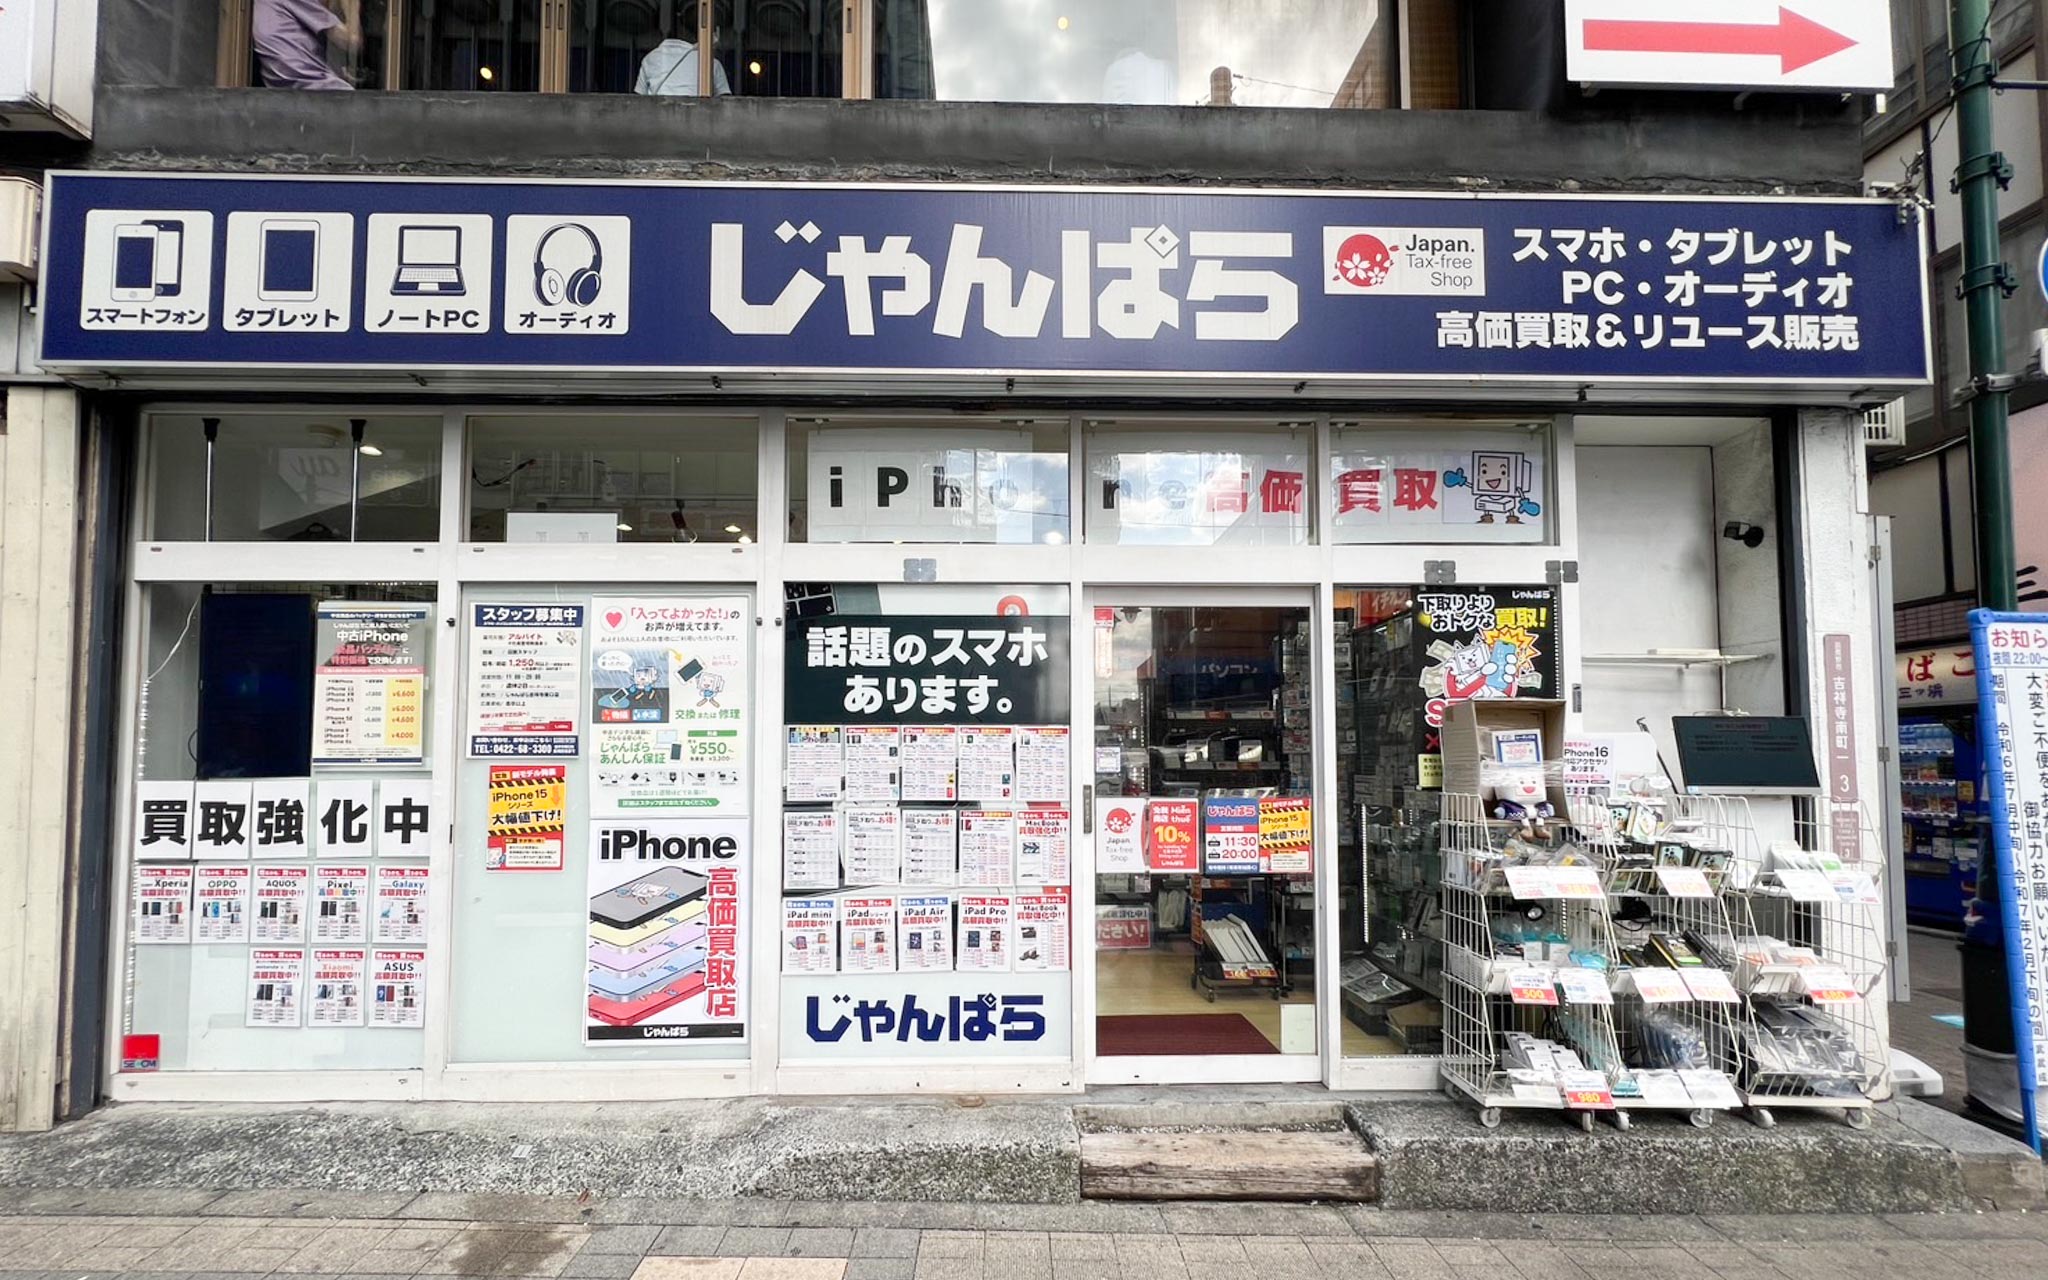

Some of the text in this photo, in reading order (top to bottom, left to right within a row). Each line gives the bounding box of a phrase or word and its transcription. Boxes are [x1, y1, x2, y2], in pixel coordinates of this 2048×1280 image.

[1405, 235, 1475, 254] Japan.
[1512, 227, 1853, 267] スマホ・タブレット
[1406, 254, 1473, 270] Tax-free
[710, 220, 1299, 340] じゃんぱら
[1431, 272, 1473, 290] Shop
[1563, 271, 1854, 308] PC・オーディオ
[86, 308, 205, 326] スマートフォン
[235, 309, 340, 328] タブレット
[376, 309, 479, 329] ノートPC
[518, 311, 617, 329] オーディオ
[1511, 590, 1551, 600] じゃんぱら
[1418, 594, 1495, 613] 下取りより
[482, 607, 578, 622] スタッフ募集中
[1431, 607, 1547, 632] おトクな 買取!
[336, 630, 409, 642] 中古iPhone
[806, 626, 1049, 667] 話題のスマホ
[843, 674, 1013, 715] あります。
[674, 709, 696, 720] 交換
[719, 708, 741, 720] 修理
[600, 753, 666, 765] あんしん保証
[1564, 746, 1609, 758] Phone16
[1840, 774, 1850, 793] 3
[492, 789, 548, 803] iPhone 15
[508, 801, 534, 810] シリーズ
[1208, 805, 1256, 817] じゃんぱら
[140, 797, 429, 846] 買取強化中
[492, 809, 562, 826] 大幅値下げ!
[1154, 825, 1191, 843] 10%
[1225, 836, 1257, 846] 11:30
[600, 829, 738, 861] iPhone
[1222, 849, 1257, 859] 20:00
[154, 879, 189, 890] Xperia
[207, 879, 238, 889] OPPO
[266, 879, 298, 888] AQUOS
[327, 879, 354, 889] Pixel
[391, 879, 425, 890] Galaxy
[787, 910, 809, 919] iPad
[904, 907, 928, 917] iPad
[964, 906, 1007, 916] iPad Pro
[704, 866, 738, 1017] 高価買取店
[384, 962, 415, 972] ASUS
[1522, 987, 1546, 1000] 500
[806, 993, 1046, 1042] じゃんぱら
[643, 1026, 689, 1037] じゃんぱら
[1577, 1091, 1601, 1103] 980
